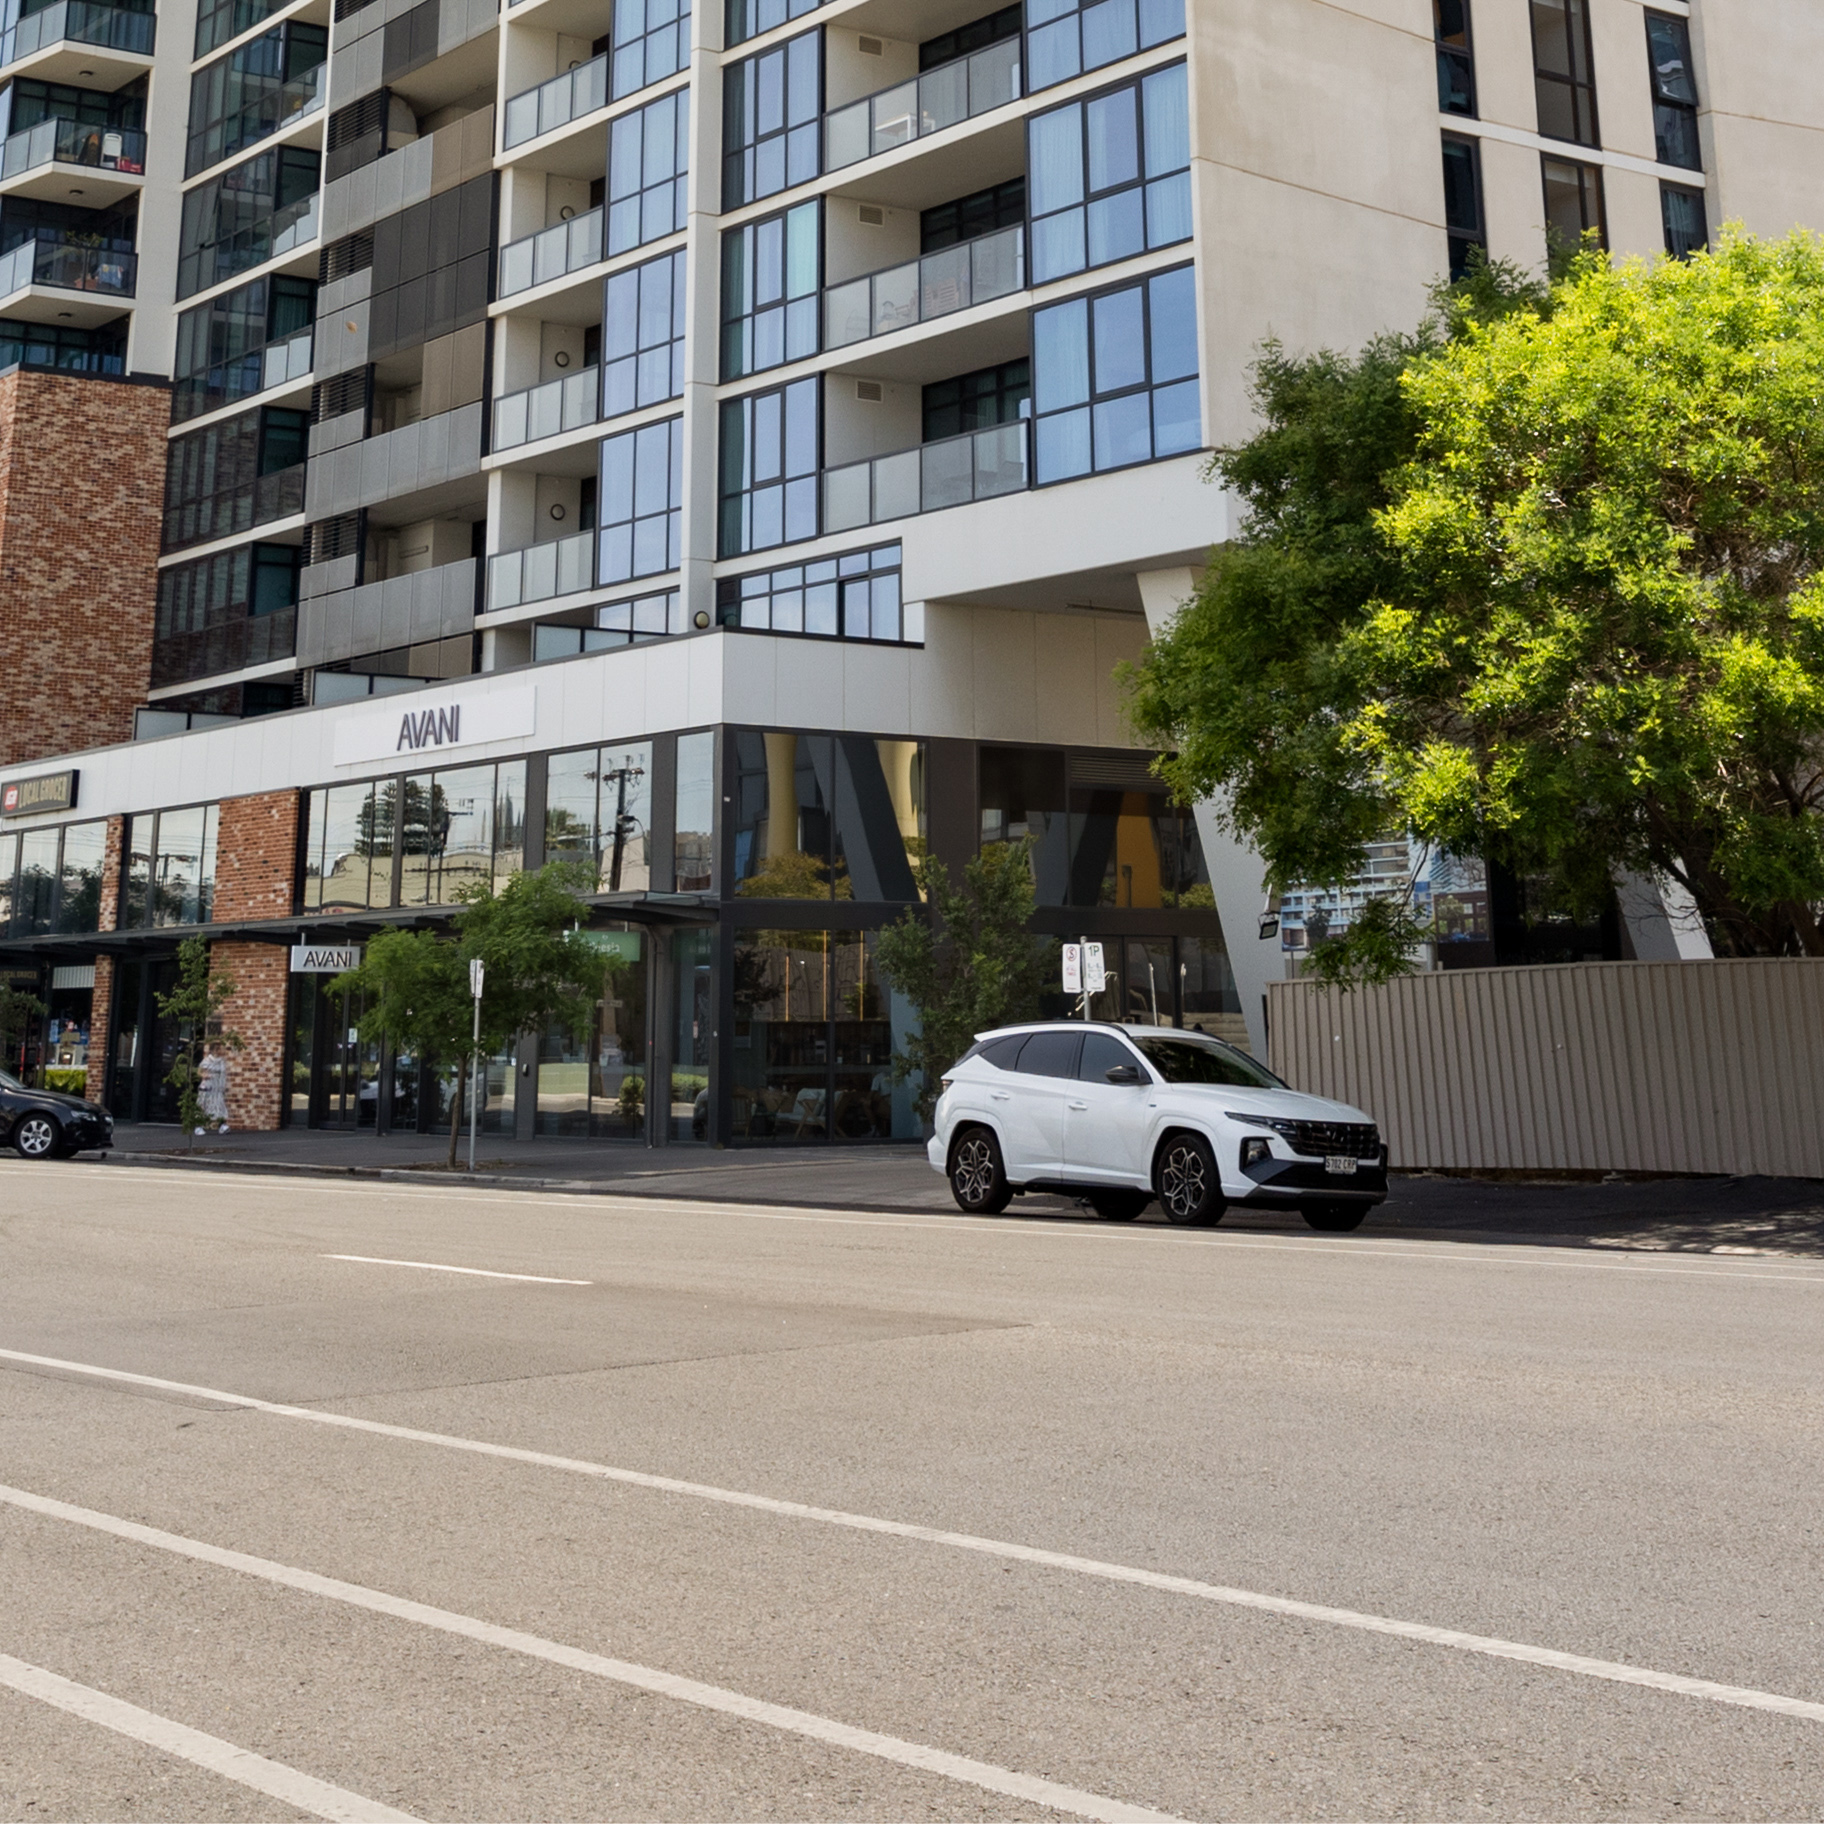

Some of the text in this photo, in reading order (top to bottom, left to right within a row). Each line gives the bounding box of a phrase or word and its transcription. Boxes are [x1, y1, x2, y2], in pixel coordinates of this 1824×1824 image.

[396, 704, 460, 752] AVANI
[19, 781, 39, 809] LOCAL
[40, 776, 67, 802] GROCER
[302, 950, 352, 968] AVANI
[1088, 945, 1100, 957] 1P
